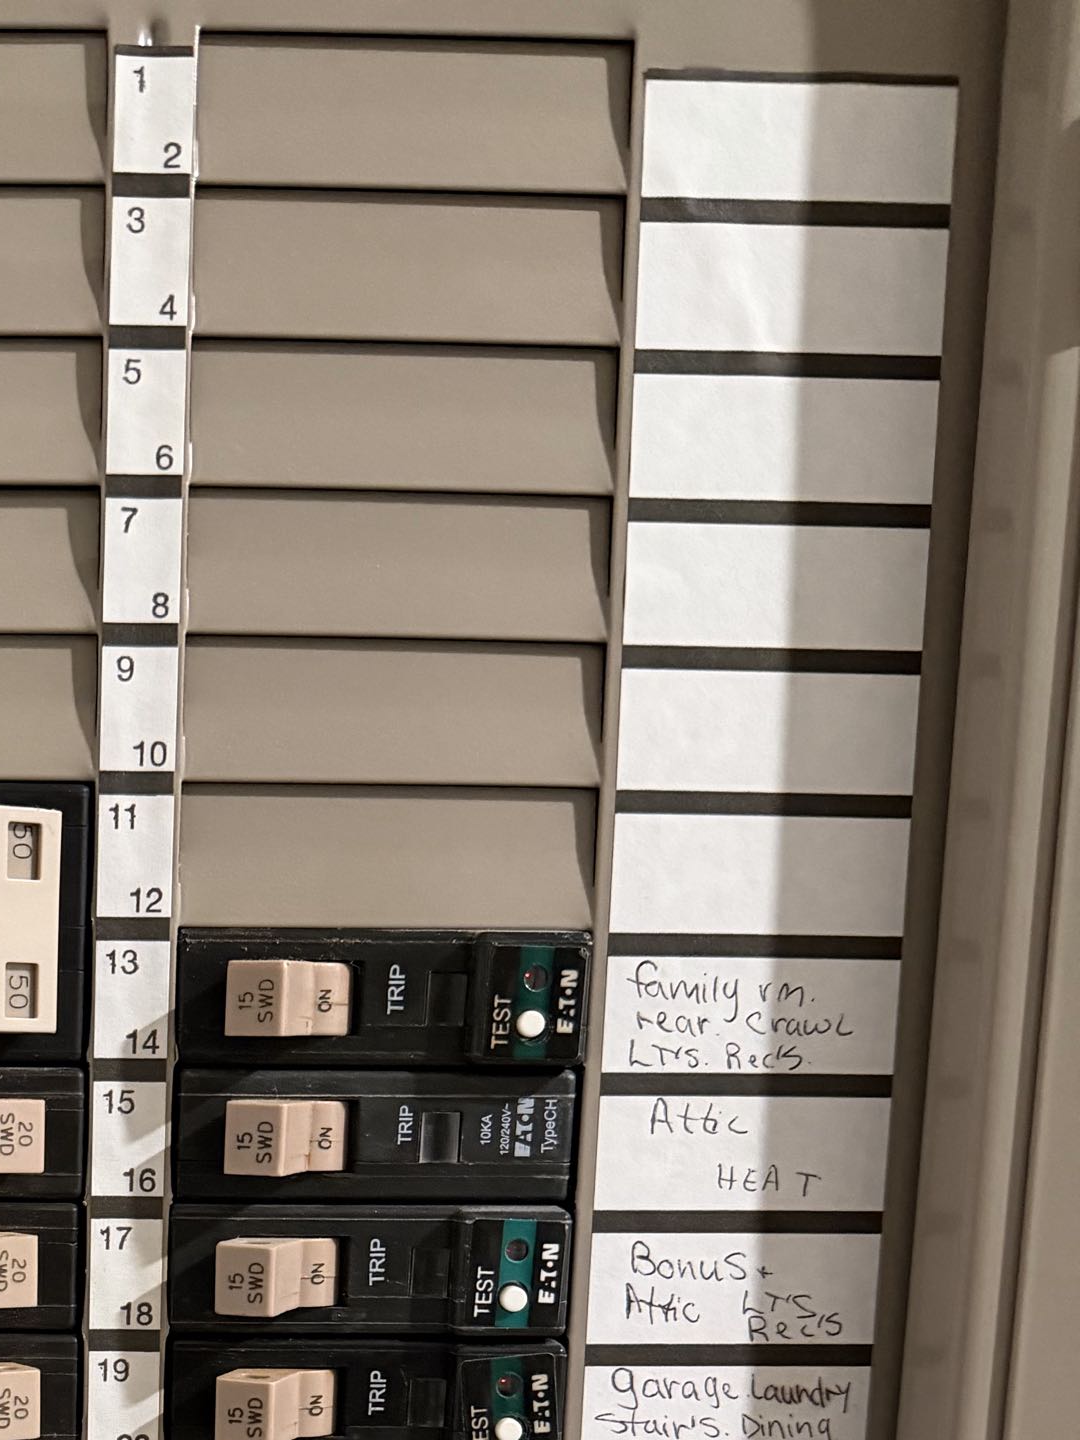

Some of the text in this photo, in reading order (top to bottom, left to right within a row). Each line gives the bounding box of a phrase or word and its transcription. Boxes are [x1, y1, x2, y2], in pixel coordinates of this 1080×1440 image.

[132, 66, 147, 93] 1
[163, 142, 182, 169] 2
[126, 206, 146, 234] 3
[159, 294, 178, 321] 4
[122, 358, 142, 385] 5
[155, 444, 174, 470] 6
[120, 506, 139, 534] 7
[151, 592, 169, 619] 8
[115, 655, 135, 682] 9
[132, 740, 168, 767] 10
[108, 803, 137, 830] 11
[12, 823, 33, 860] 50
[129, 887, 164, 913] 12
[105, 949, 140, 975] 13
[8, 974, 29, 1010] 50
[238, 991, 254, 1012] 15
[258, 978, 275, 1024] SWD
[317, 988, 333, 1013] ON
[386, 963, 408, 1015] TRIP
[490, 993, 513, 1050] TEST
[125, 1028, 160, 1055] 14
[103, 1089, 135, 1114] 15
[480, 1113, 494, 1146] 10KA
[649, 1097, 749, 1135] Attic
[0, 1112, 16, 1157] SWD
[17, 1120, 34, 1148] 20
[122, 1167, 157, 1193] 16
[716, 1163, 822, 1197] HEAT
[99, 1226, 133, 1250] 17
[119, 1301, 154, 1326] 18
[97, 1358, 130, 1383] 19
